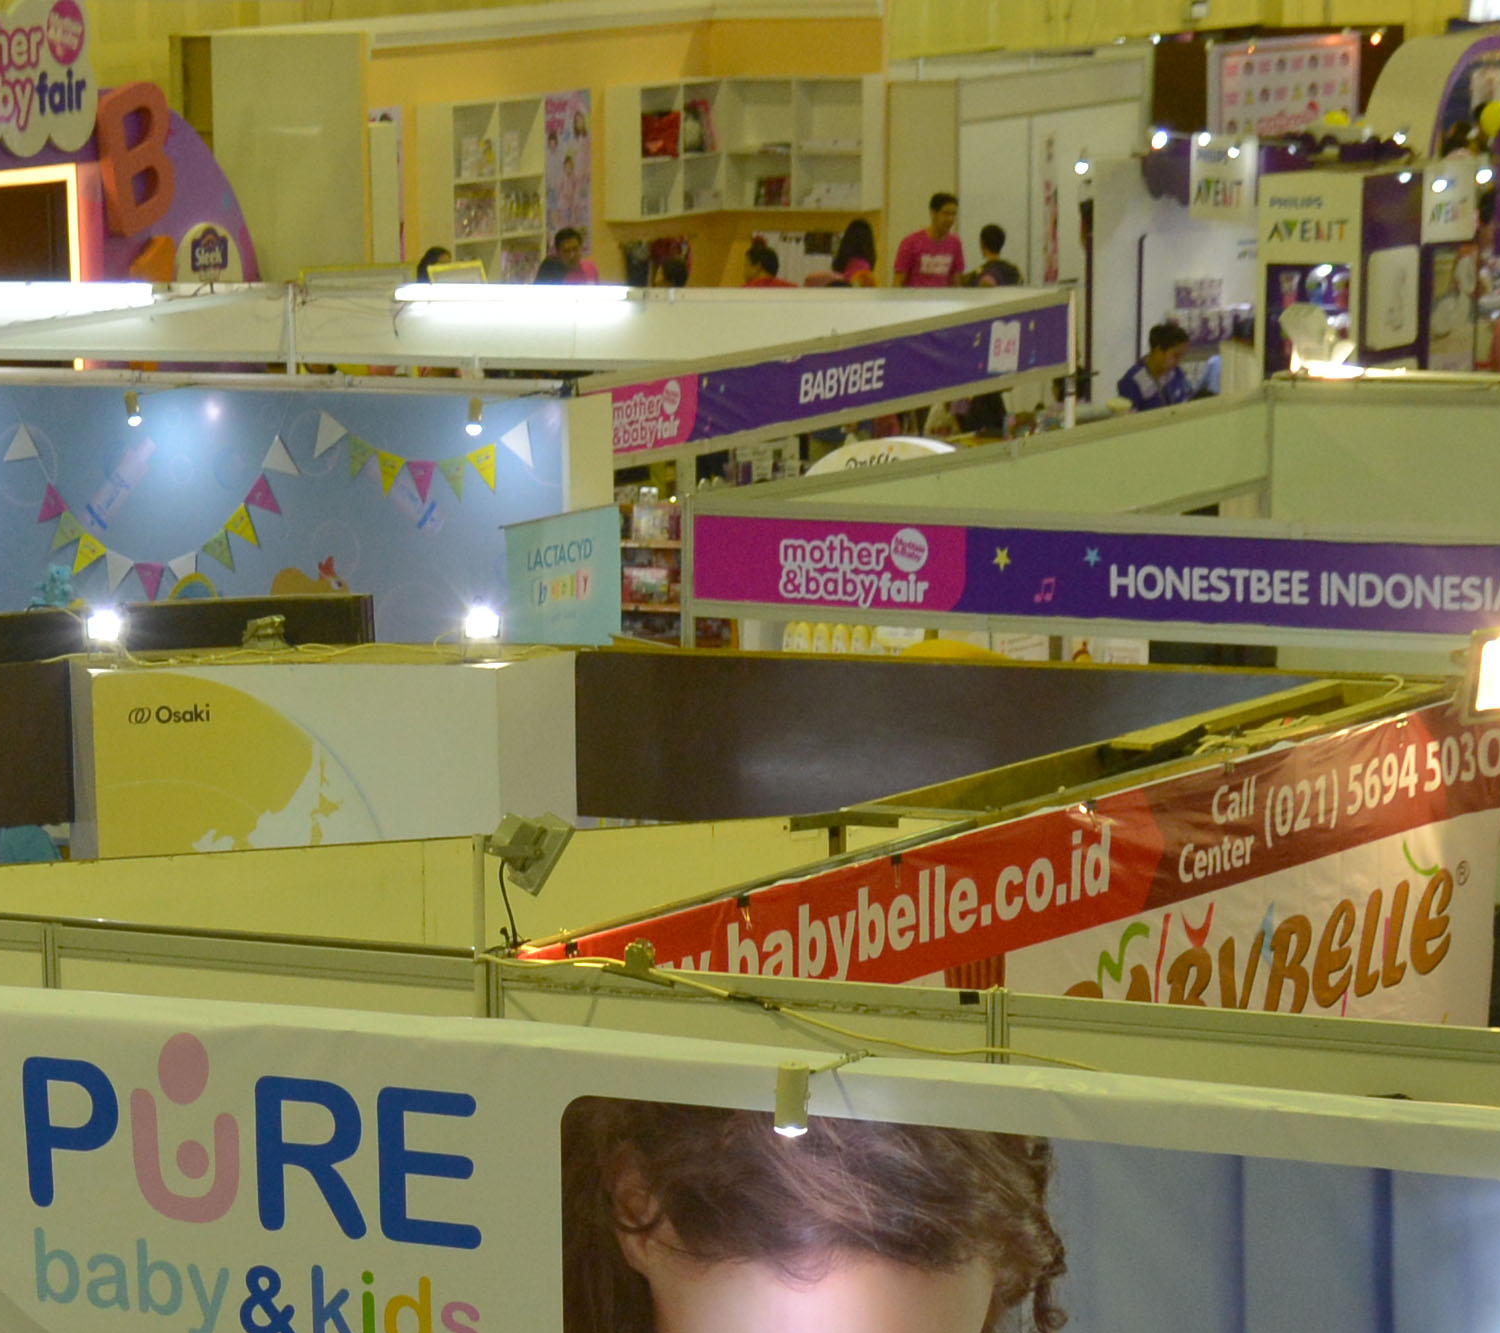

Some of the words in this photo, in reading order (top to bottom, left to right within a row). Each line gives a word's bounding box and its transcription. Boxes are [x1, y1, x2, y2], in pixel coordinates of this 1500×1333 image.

[37, 69, 87, 116] fair
[799, 357, 886, 404] BABYBEE
[526, 539, 595, 572] LACTACYD
[779, 537, 888, 572] mother
[779, 566, 878, 608] &baby
[879, 572, 930, 603] fair
[1109, 564, 1311, 603] HONESTBEE
[154, 702, 211, 724] Osaki
[1211, 783, 1255, 824] Call
[1264, 775, 1339, 843] (021)
[1345, 741, 1419, 817] 5694
[1178, 836, 1253, 884] Center
[20, 1031, 483, 1251] PURE
